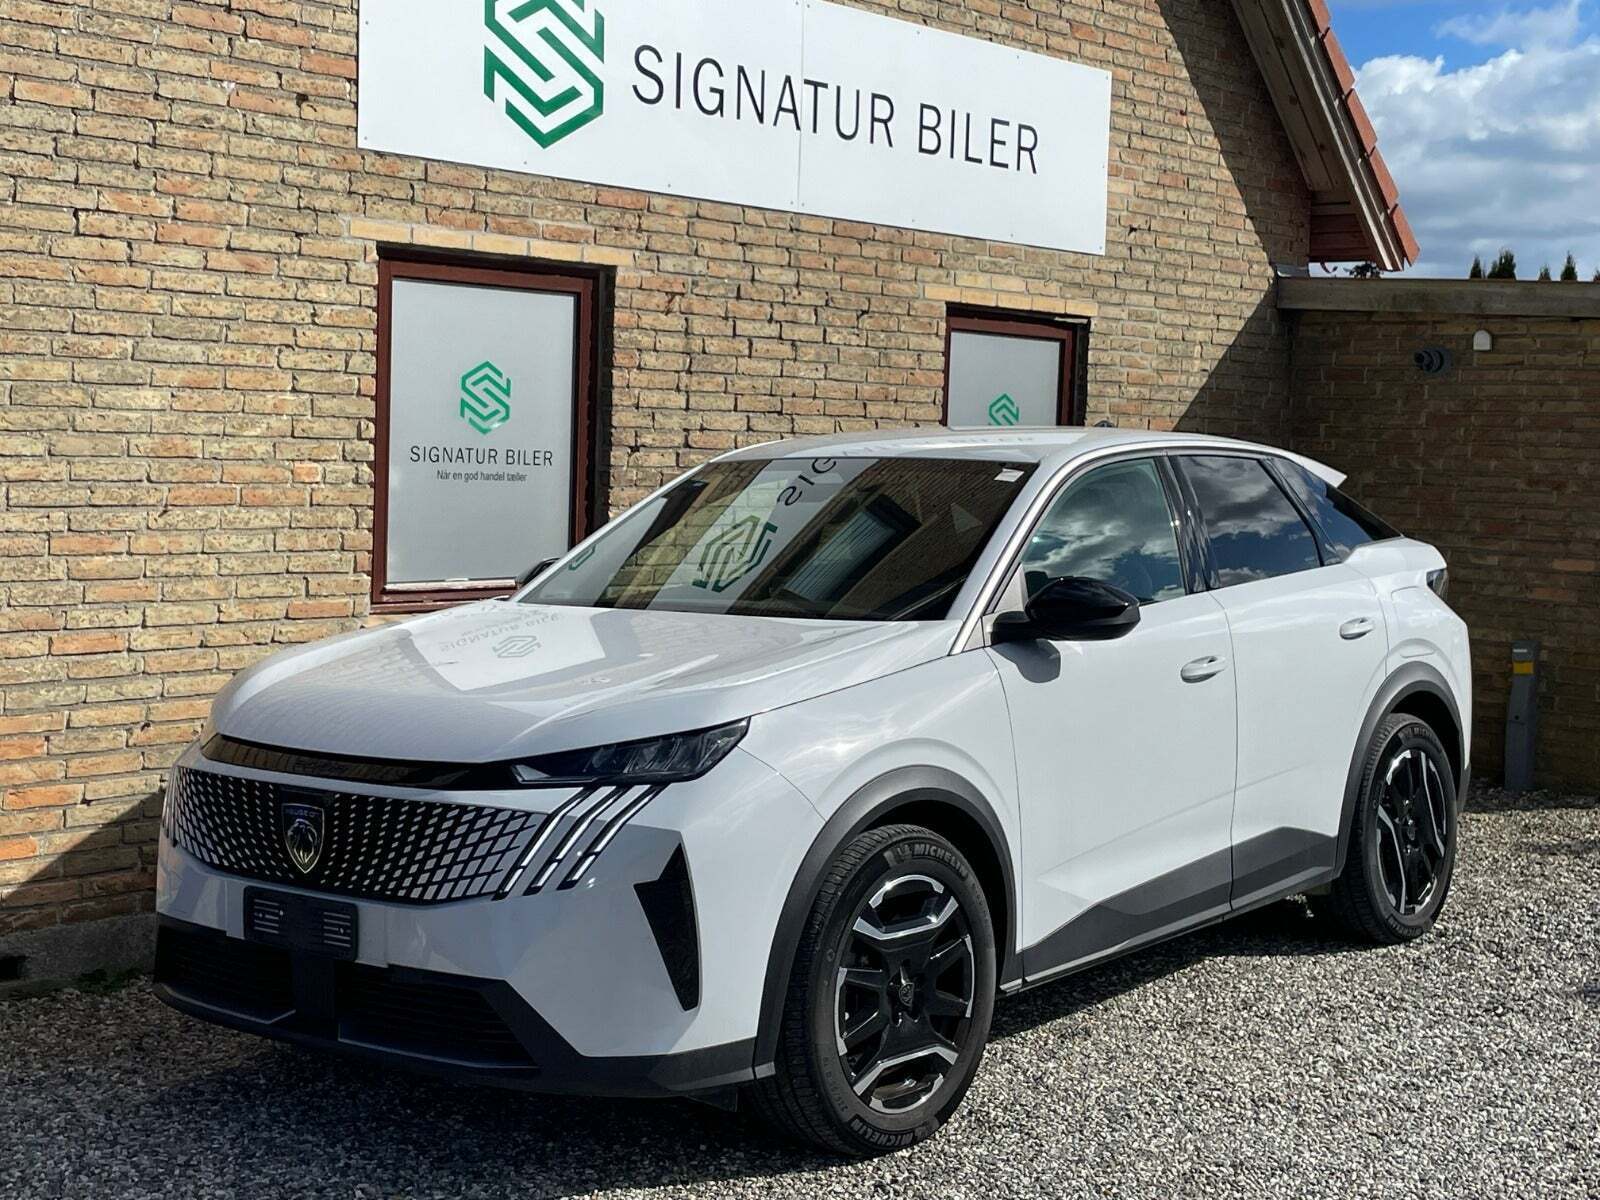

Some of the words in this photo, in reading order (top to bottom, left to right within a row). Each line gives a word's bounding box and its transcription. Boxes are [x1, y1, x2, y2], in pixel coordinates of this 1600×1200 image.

[632, 44, 894, 148] SIGNATUR
[918, 102, 1038, 175] BILER
[409, 445, 498, 465] SIGNATUR
[505, 449, 553, 467] BILER
[437, 470, 451, 481] Når
[452, 472, 463, 481] en
[464, 471, 479, 483] god
[480, 471, 505, 481] handel
[914, 843, 969, 879] MICHELIN
[850, 1118, 914, 1147] MICHELIN
